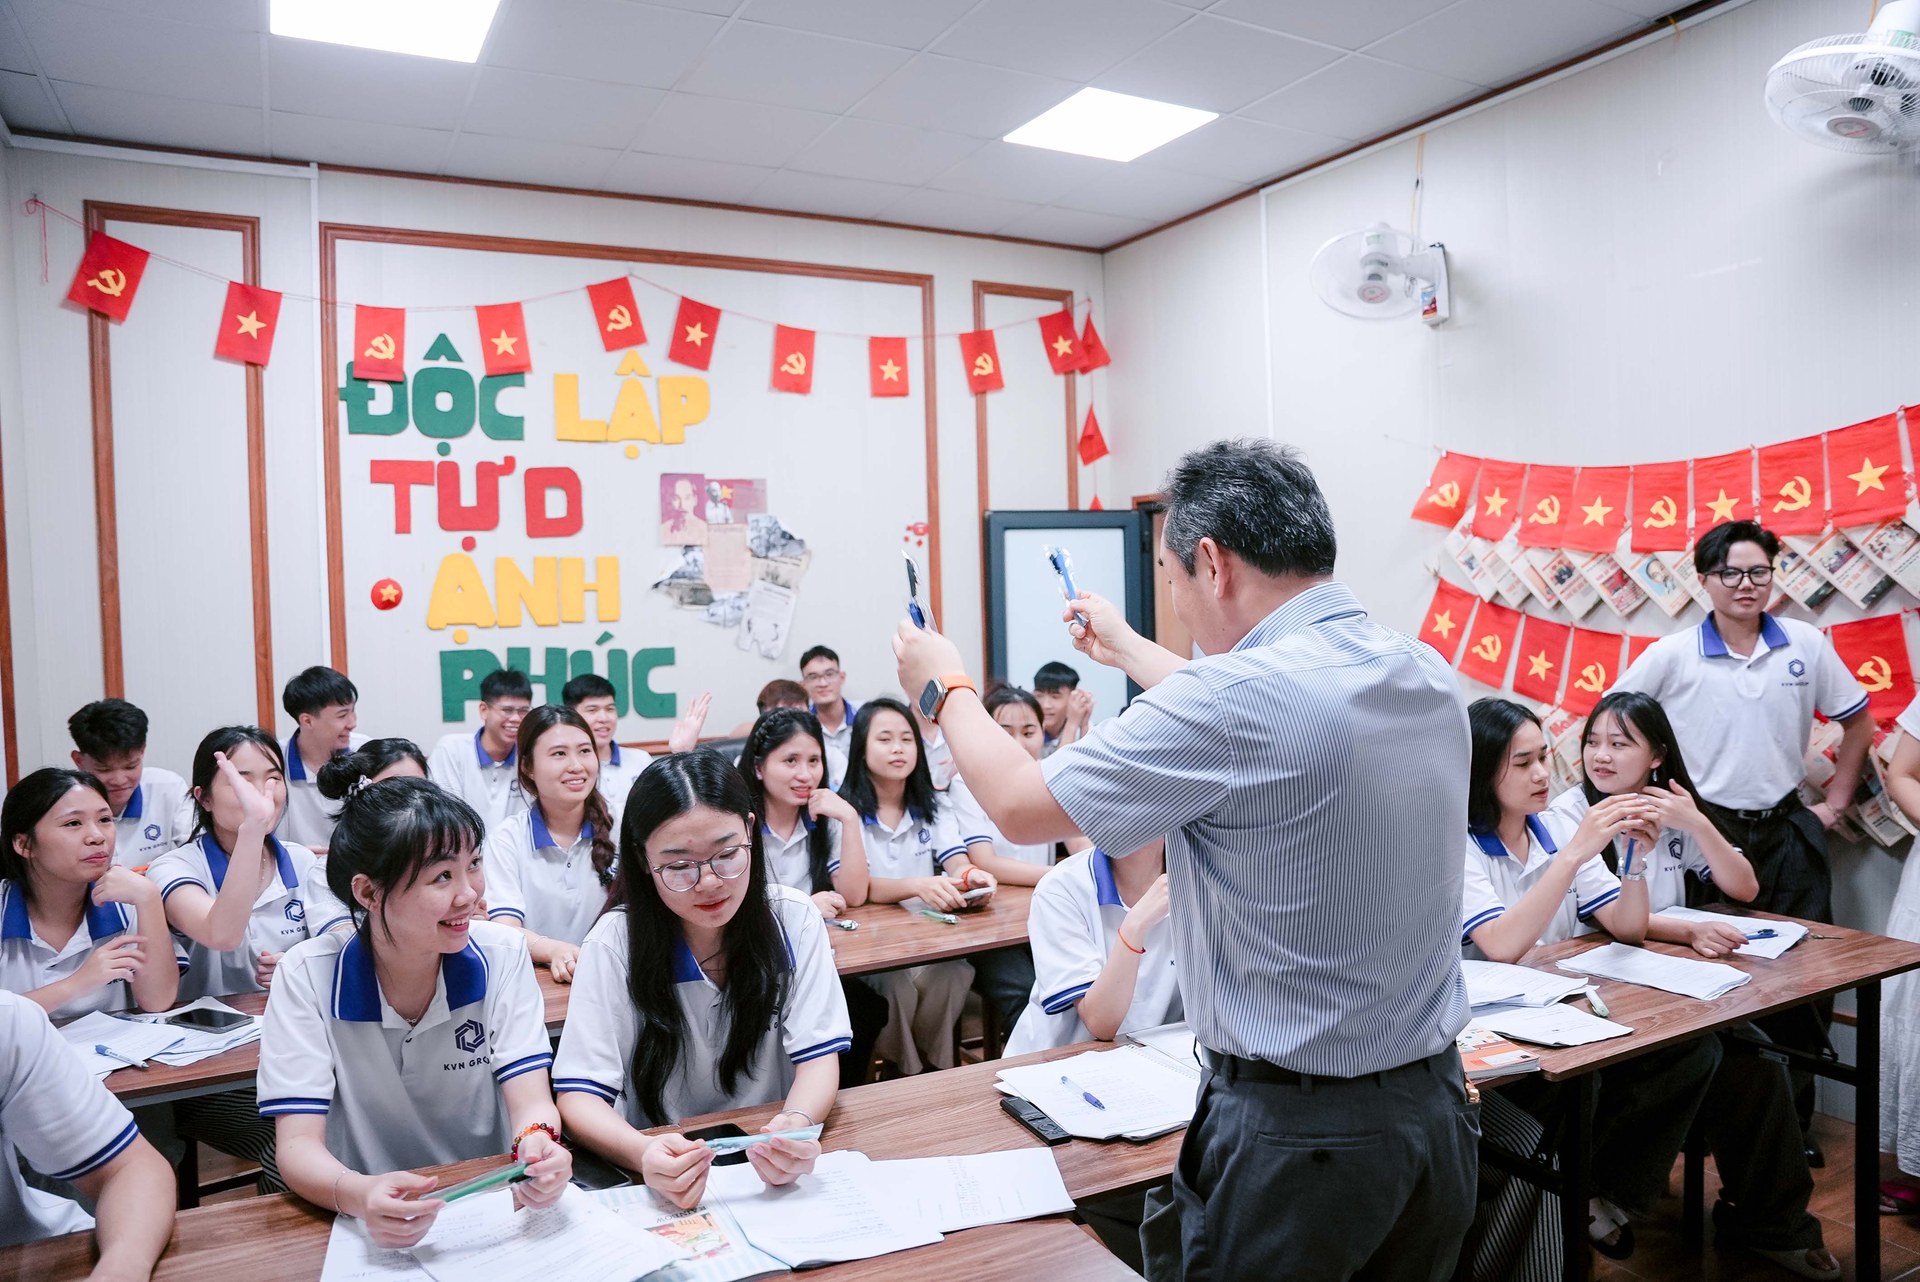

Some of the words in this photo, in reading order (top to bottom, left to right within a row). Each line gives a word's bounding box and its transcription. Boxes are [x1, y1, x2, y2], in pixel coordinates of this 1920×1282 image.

[553, 349, 711, 459] LẬP
[370, 455, 516, 552] TỰ
[426, 553, 621, 644] ẠNH
[443, 1062, 465, 1071] KVN
[469, 1056, 490, 1067] GRO
